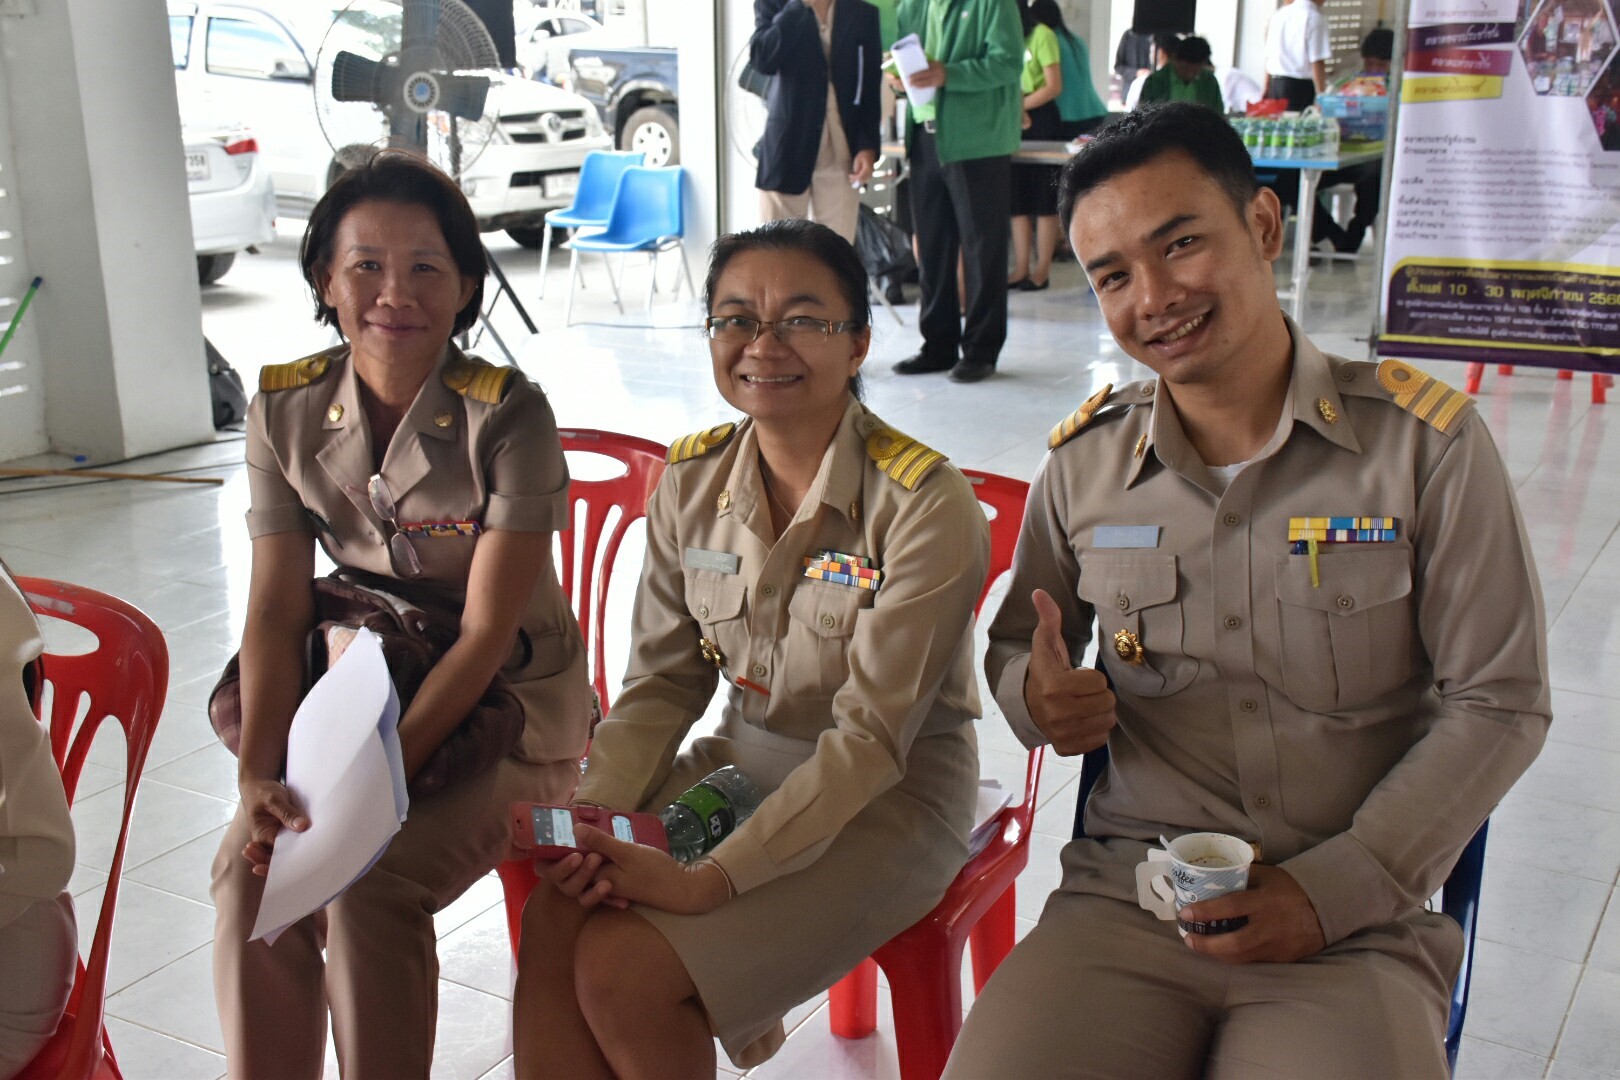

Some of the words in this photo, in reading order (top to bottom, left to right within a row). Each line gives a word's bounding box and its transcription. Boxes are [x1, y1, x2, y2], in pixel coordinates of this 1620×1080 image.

[1406, 276, 1442, 295] ตั้งแต่
[1450, 283, 1468, 296] 10
[1484, 284, 1504, 298] 30
[1511, 286, 1584, 302] พฤศจิกายน
